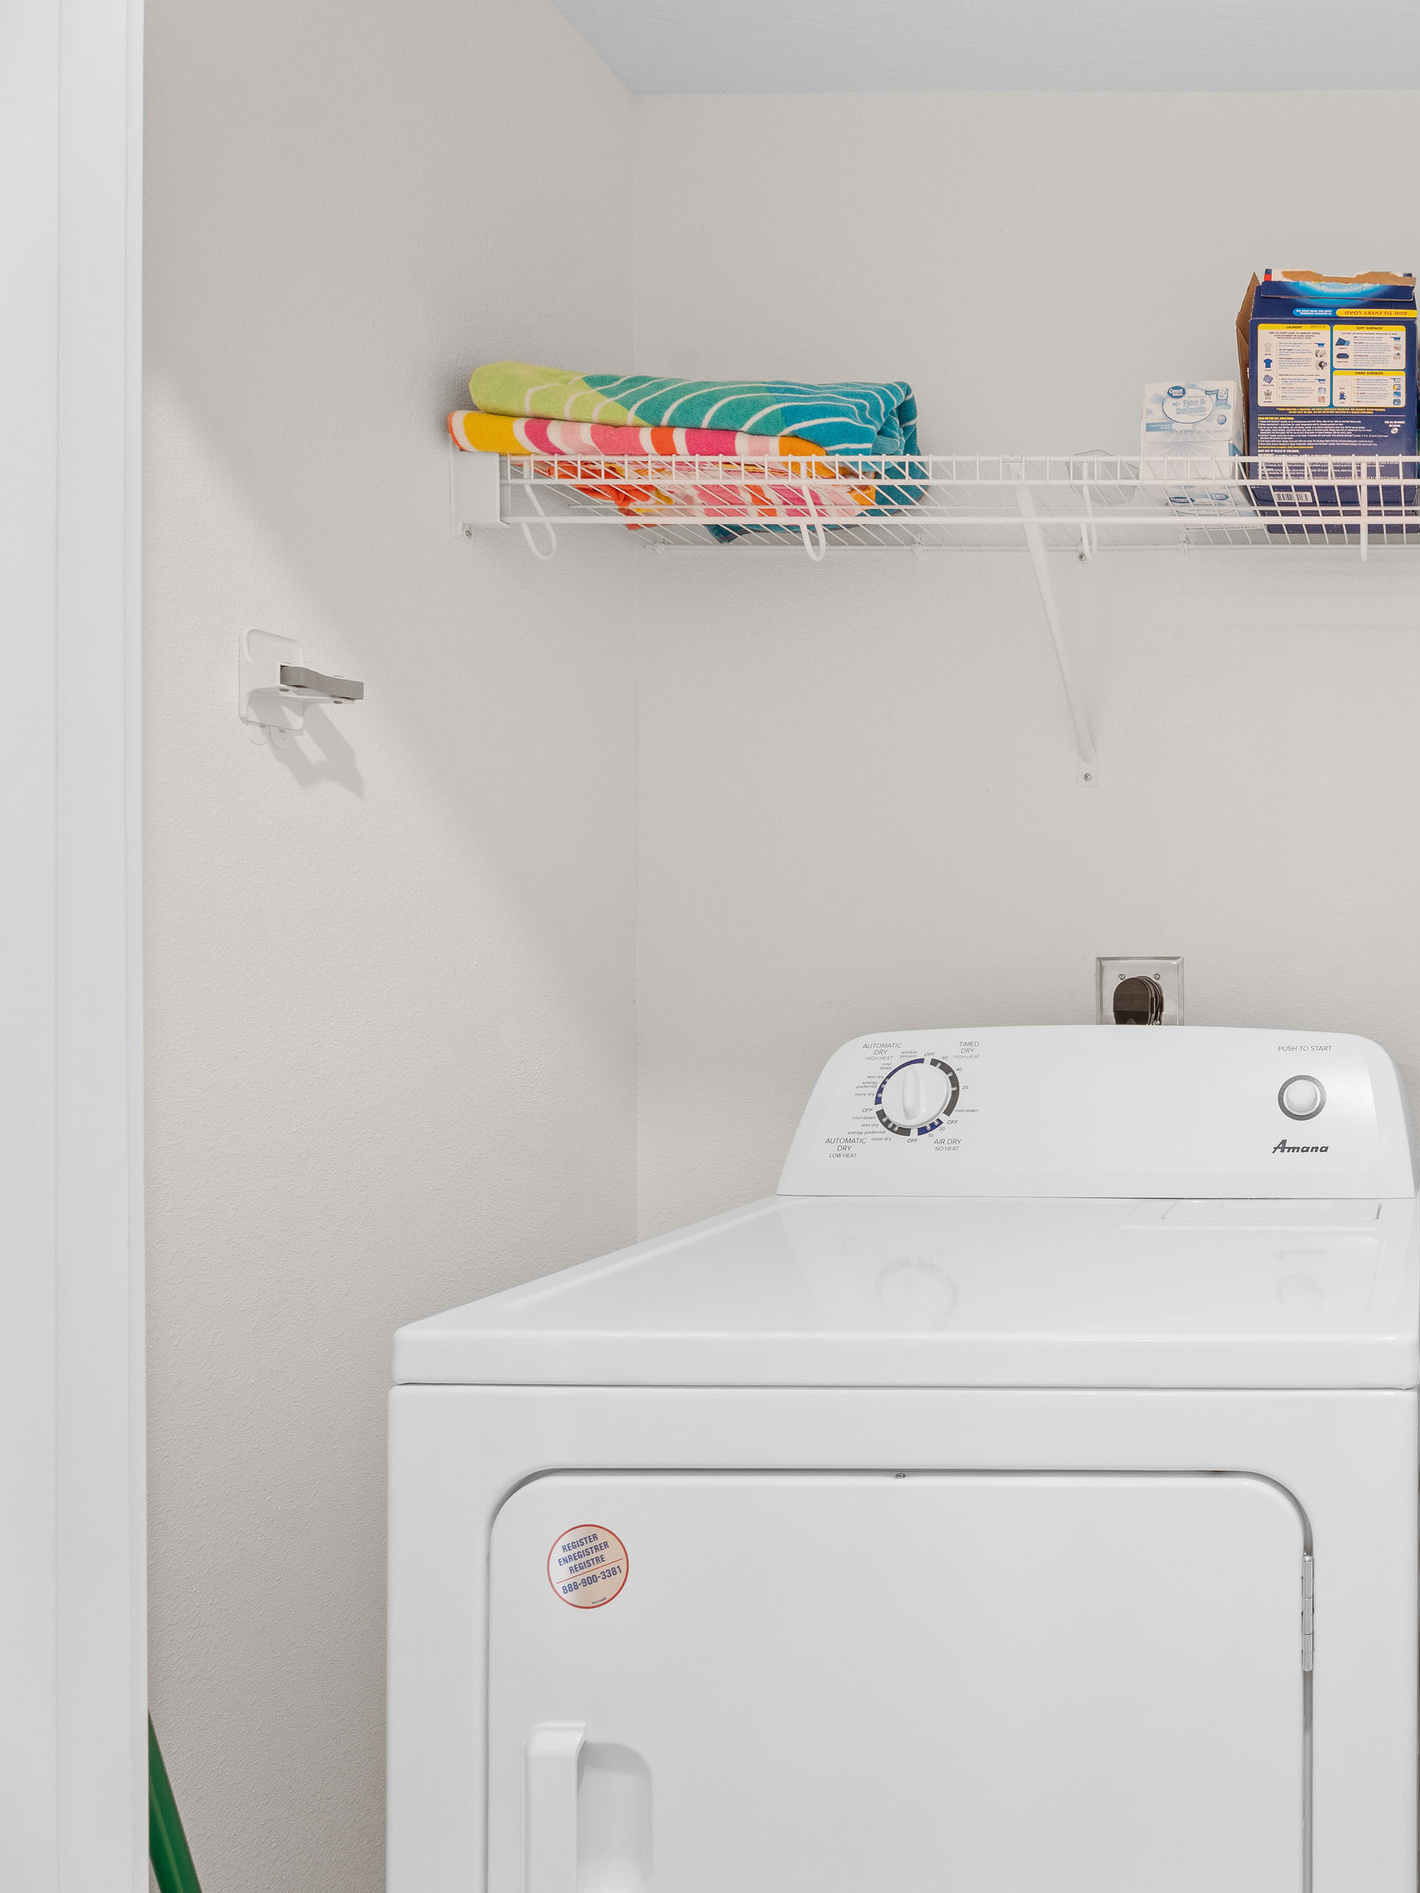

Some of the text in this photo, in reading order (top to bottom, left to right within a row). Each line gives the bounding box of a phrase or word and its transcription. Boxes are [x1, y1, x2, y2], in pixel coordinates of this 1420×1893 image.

[1271, 1139, 1330, 1154] Amana
[561, 1533, 599, 1553] REGISTER
[557, 1541, 610, 1567] ENREGISTRER
[568, 1554, 606, 1574] REGISTRE
[561, 1565, 622, 1594] 888-900-3381
